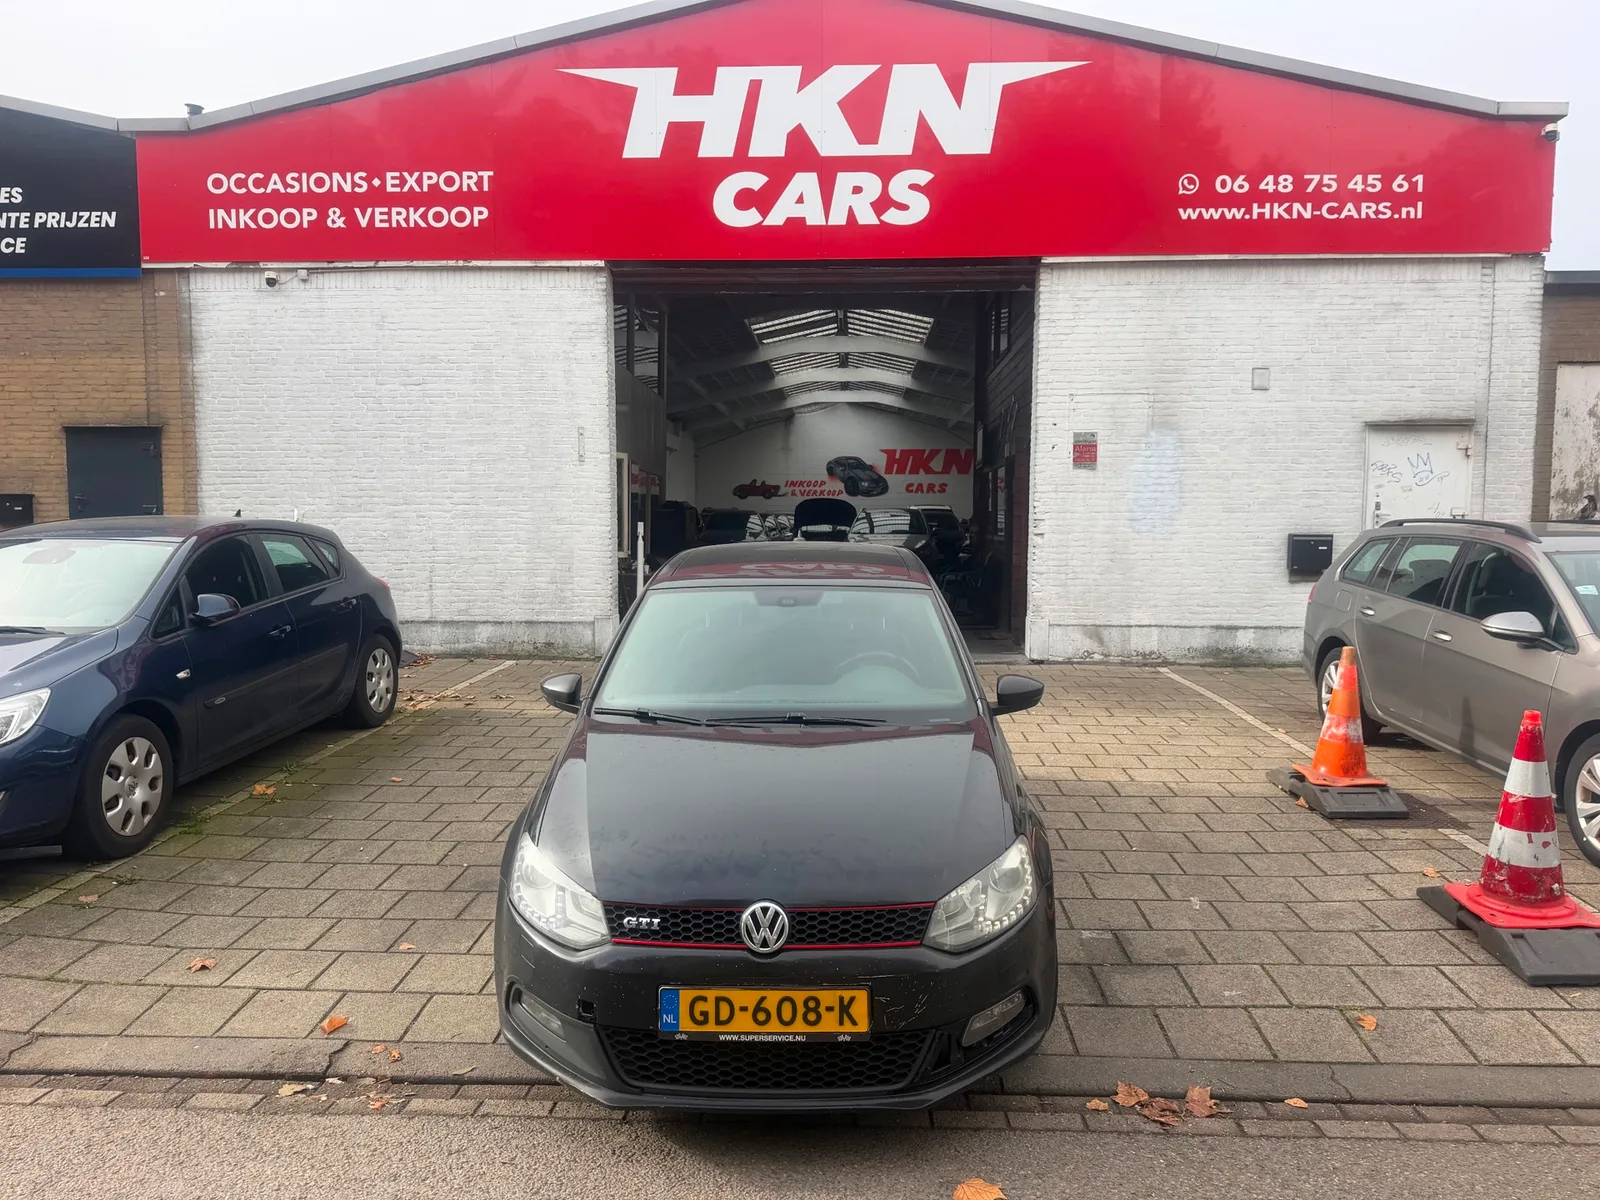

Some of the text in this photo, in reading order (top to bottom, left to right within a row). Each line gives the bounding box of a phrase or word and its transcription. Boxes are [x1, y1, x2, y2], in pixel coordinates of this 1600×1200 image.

[555, 61, 1092, 159] HKN
[206, 170, 494, 195] OCCASIONS EXPORT
[1215, 174, 1424, 194] 06 48 75 45 61
[0, 186, 23, 204] ES
[712, 168, 935, 228] CARS
[33, 211, 117, 228] PRIJZEN
[208, 206, 489, 229] INKOOP & VERKOOP
[1178, 201, 1423, 220] www.HKN-CARS.nl
[0, 237, 27, 253] CE
[880, 448, 974, 475] HKN
[784, 480, 827, 488] INKOOP
[799, 488, 844, 497] VERKOOP
[904, 482, 948, 494] CARS
[623, 916, 661, 931] GTI
[662, 1014, 677, 1024] NL
[688, 995, 859, 1027] GD-608-K
[718, 1034, 807, 1042] WWW.SUPERSERVICE.NU
